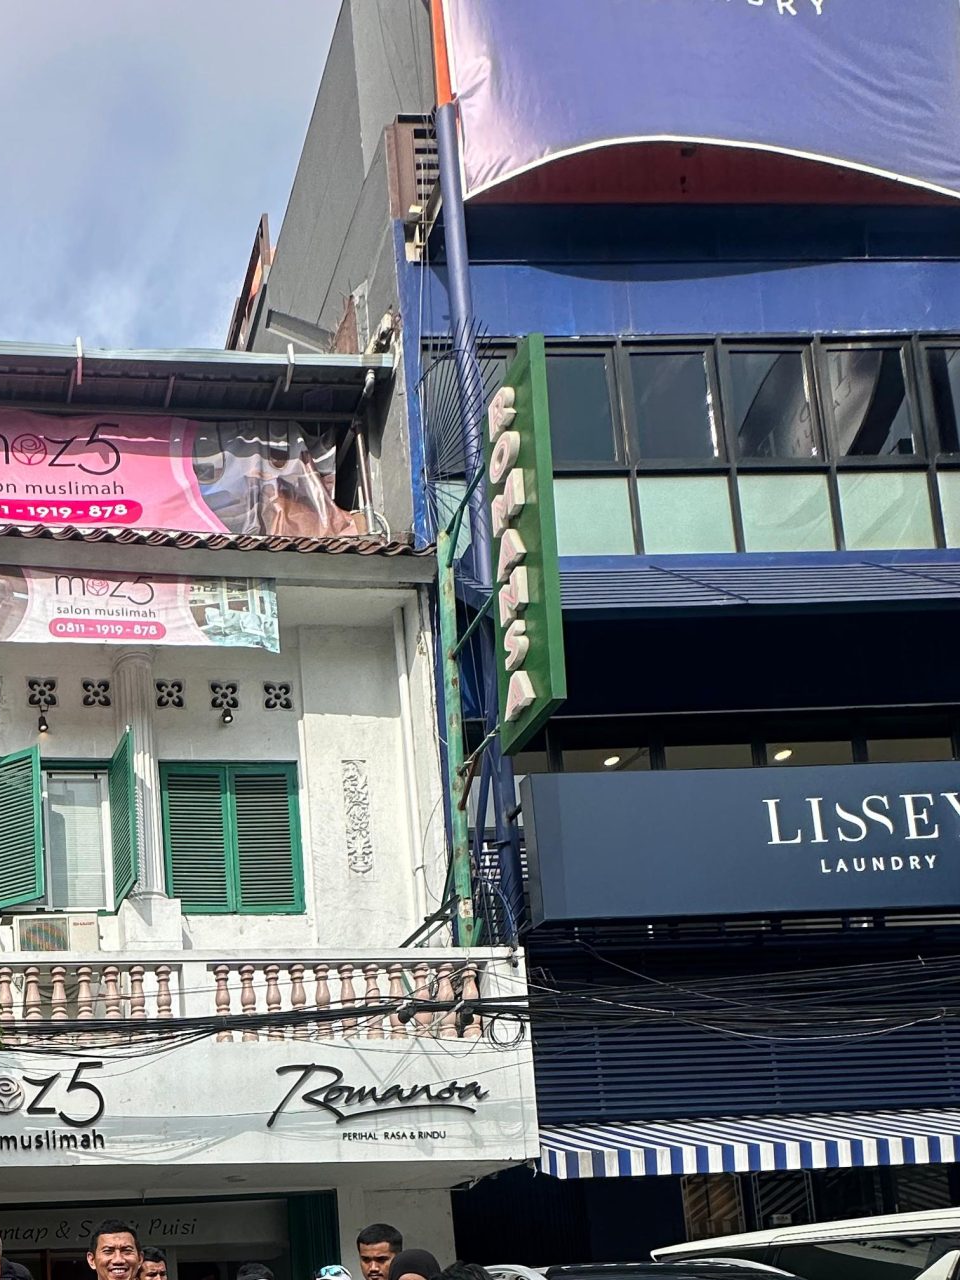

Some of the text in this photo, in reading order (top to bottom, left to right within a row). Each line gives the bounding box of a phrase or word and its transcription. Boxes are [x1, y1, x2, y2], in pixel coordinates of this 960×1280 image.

[25, 481, 125, 495] muslimah
[27, 505, 73, 519] 1919
[88, 504, 128, 519] 878
[488, 386, 536, 722] ROMANSA
[55, 575, 155, 605] moz5
[57, 605, 156, 619] salon muslimah
[56, 623, 85, 633] 0811
[96, 624, 123, 636] 1919
[133, 625, 158, 636] 878
[820, 855, 936, 873] LAUNDRY
[266, 1063, 490, 1128] Romansa
[0, 1129, 105, 1150] muslimah
[342, 1131, 447, 1141] PERIHAL RASA & RINDU
[55, 1220, 71, 1239] &
[148, 1218, 197, 1235] Puisi
